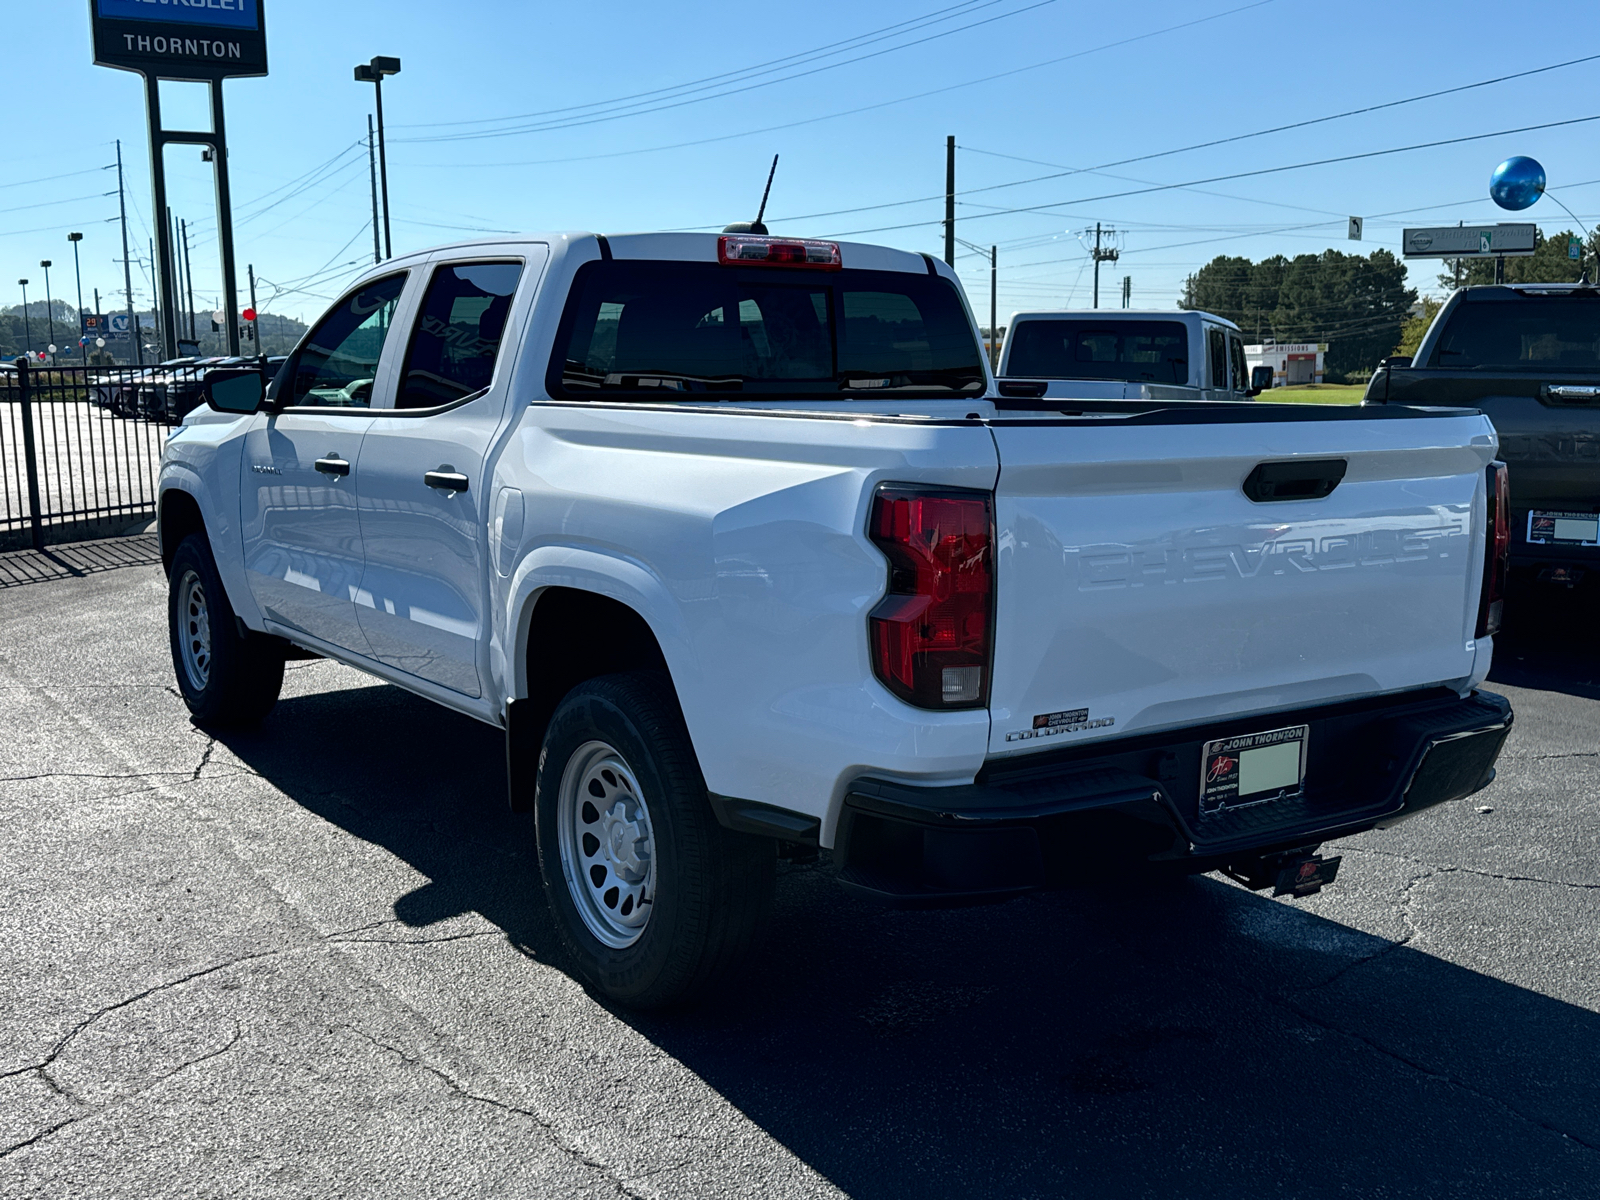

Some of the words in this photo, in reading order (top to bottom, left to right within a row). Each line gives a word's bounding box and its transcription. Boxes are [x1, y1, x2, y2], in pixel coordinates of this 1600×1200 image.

[123, 34, 241, 59] THORNTON
[1483, 241, 1488, 250] 6
[1077, 523, 1463, 592] CHEVROLET
[1005, 716, 1115, 742] COLORADO
[1227, 737, 1253, 750] JOHN
[1255, 728, 1303, 745] THORNTON
